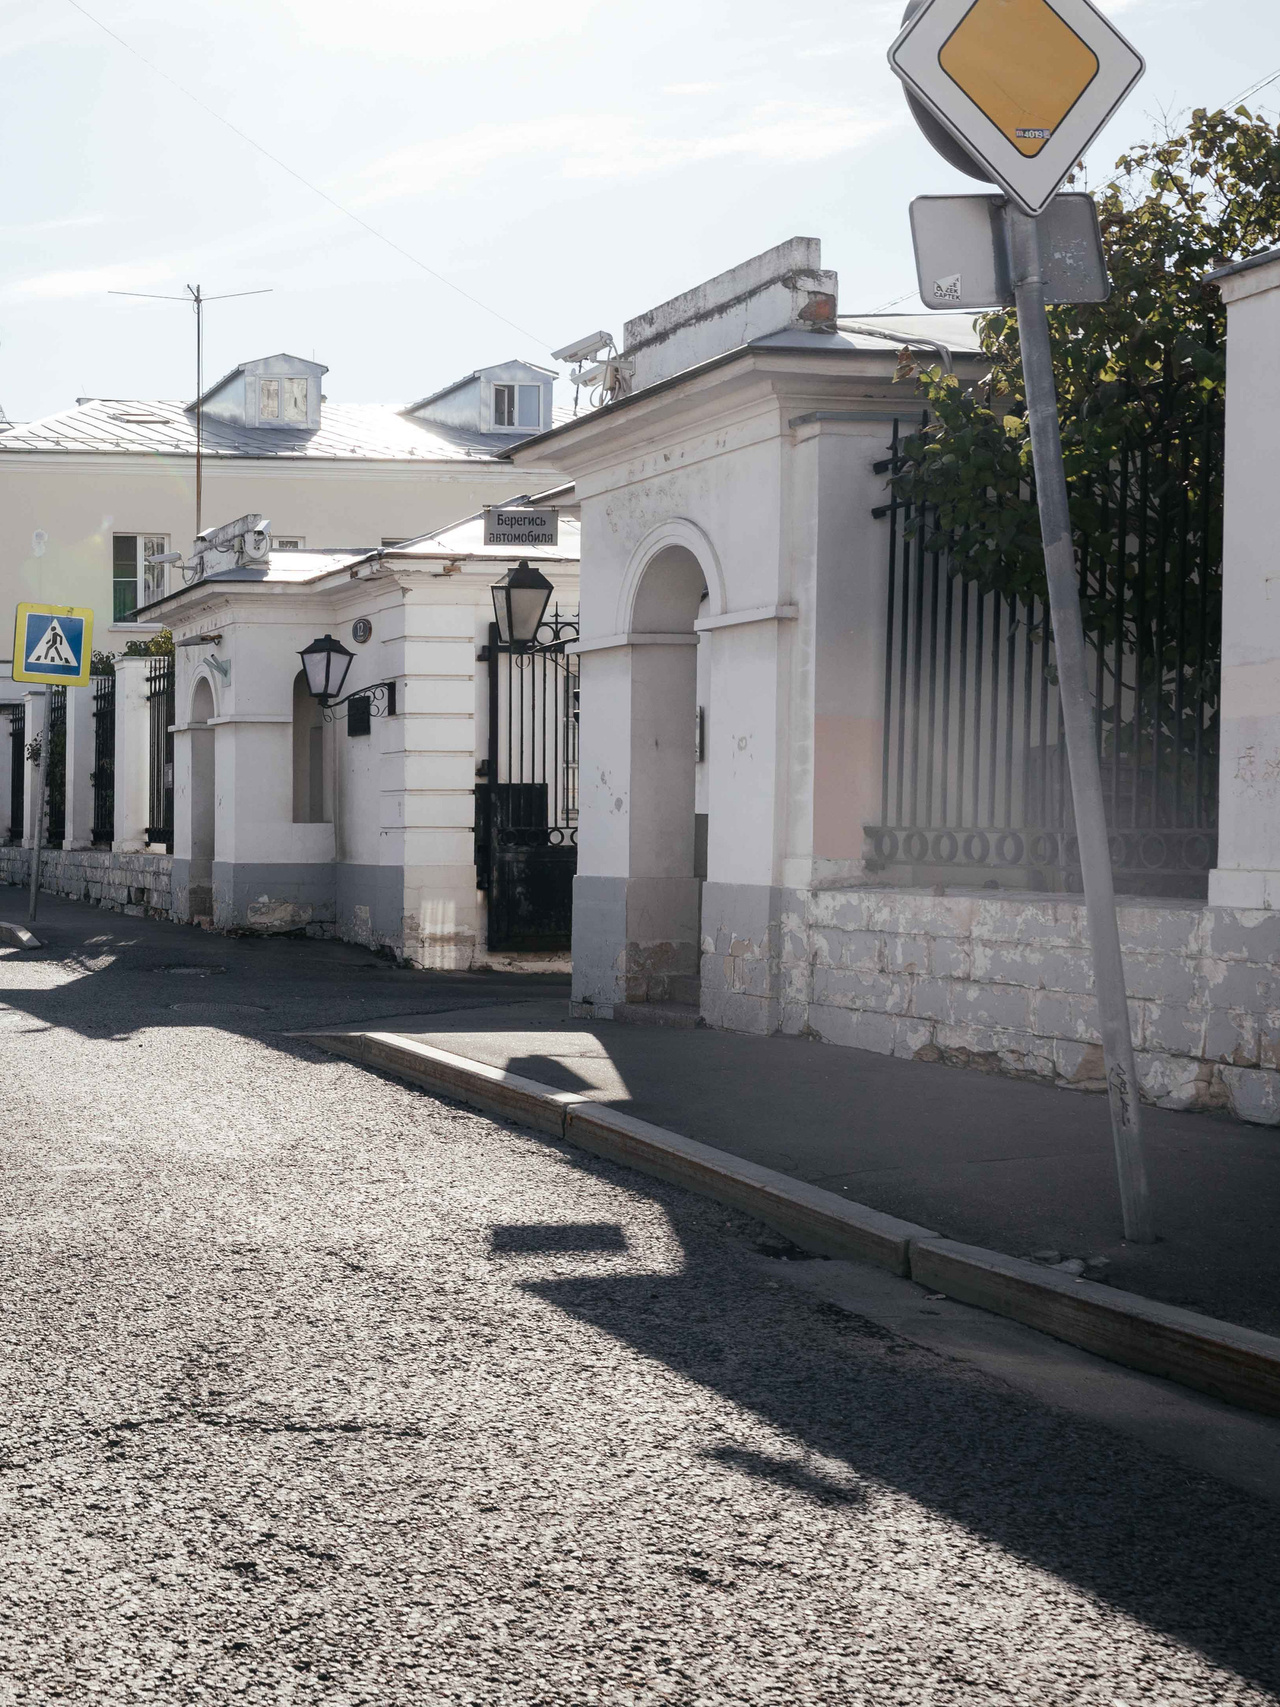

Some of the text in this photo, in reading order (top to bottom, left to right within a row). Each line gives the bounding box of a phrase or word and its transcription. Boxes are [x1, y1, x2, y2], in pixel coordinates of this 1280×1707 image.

[497, 514, 546, 528] Берегись
[489, 531, 553, 543] автомобиля
[357, 622, 364, 636] 12
